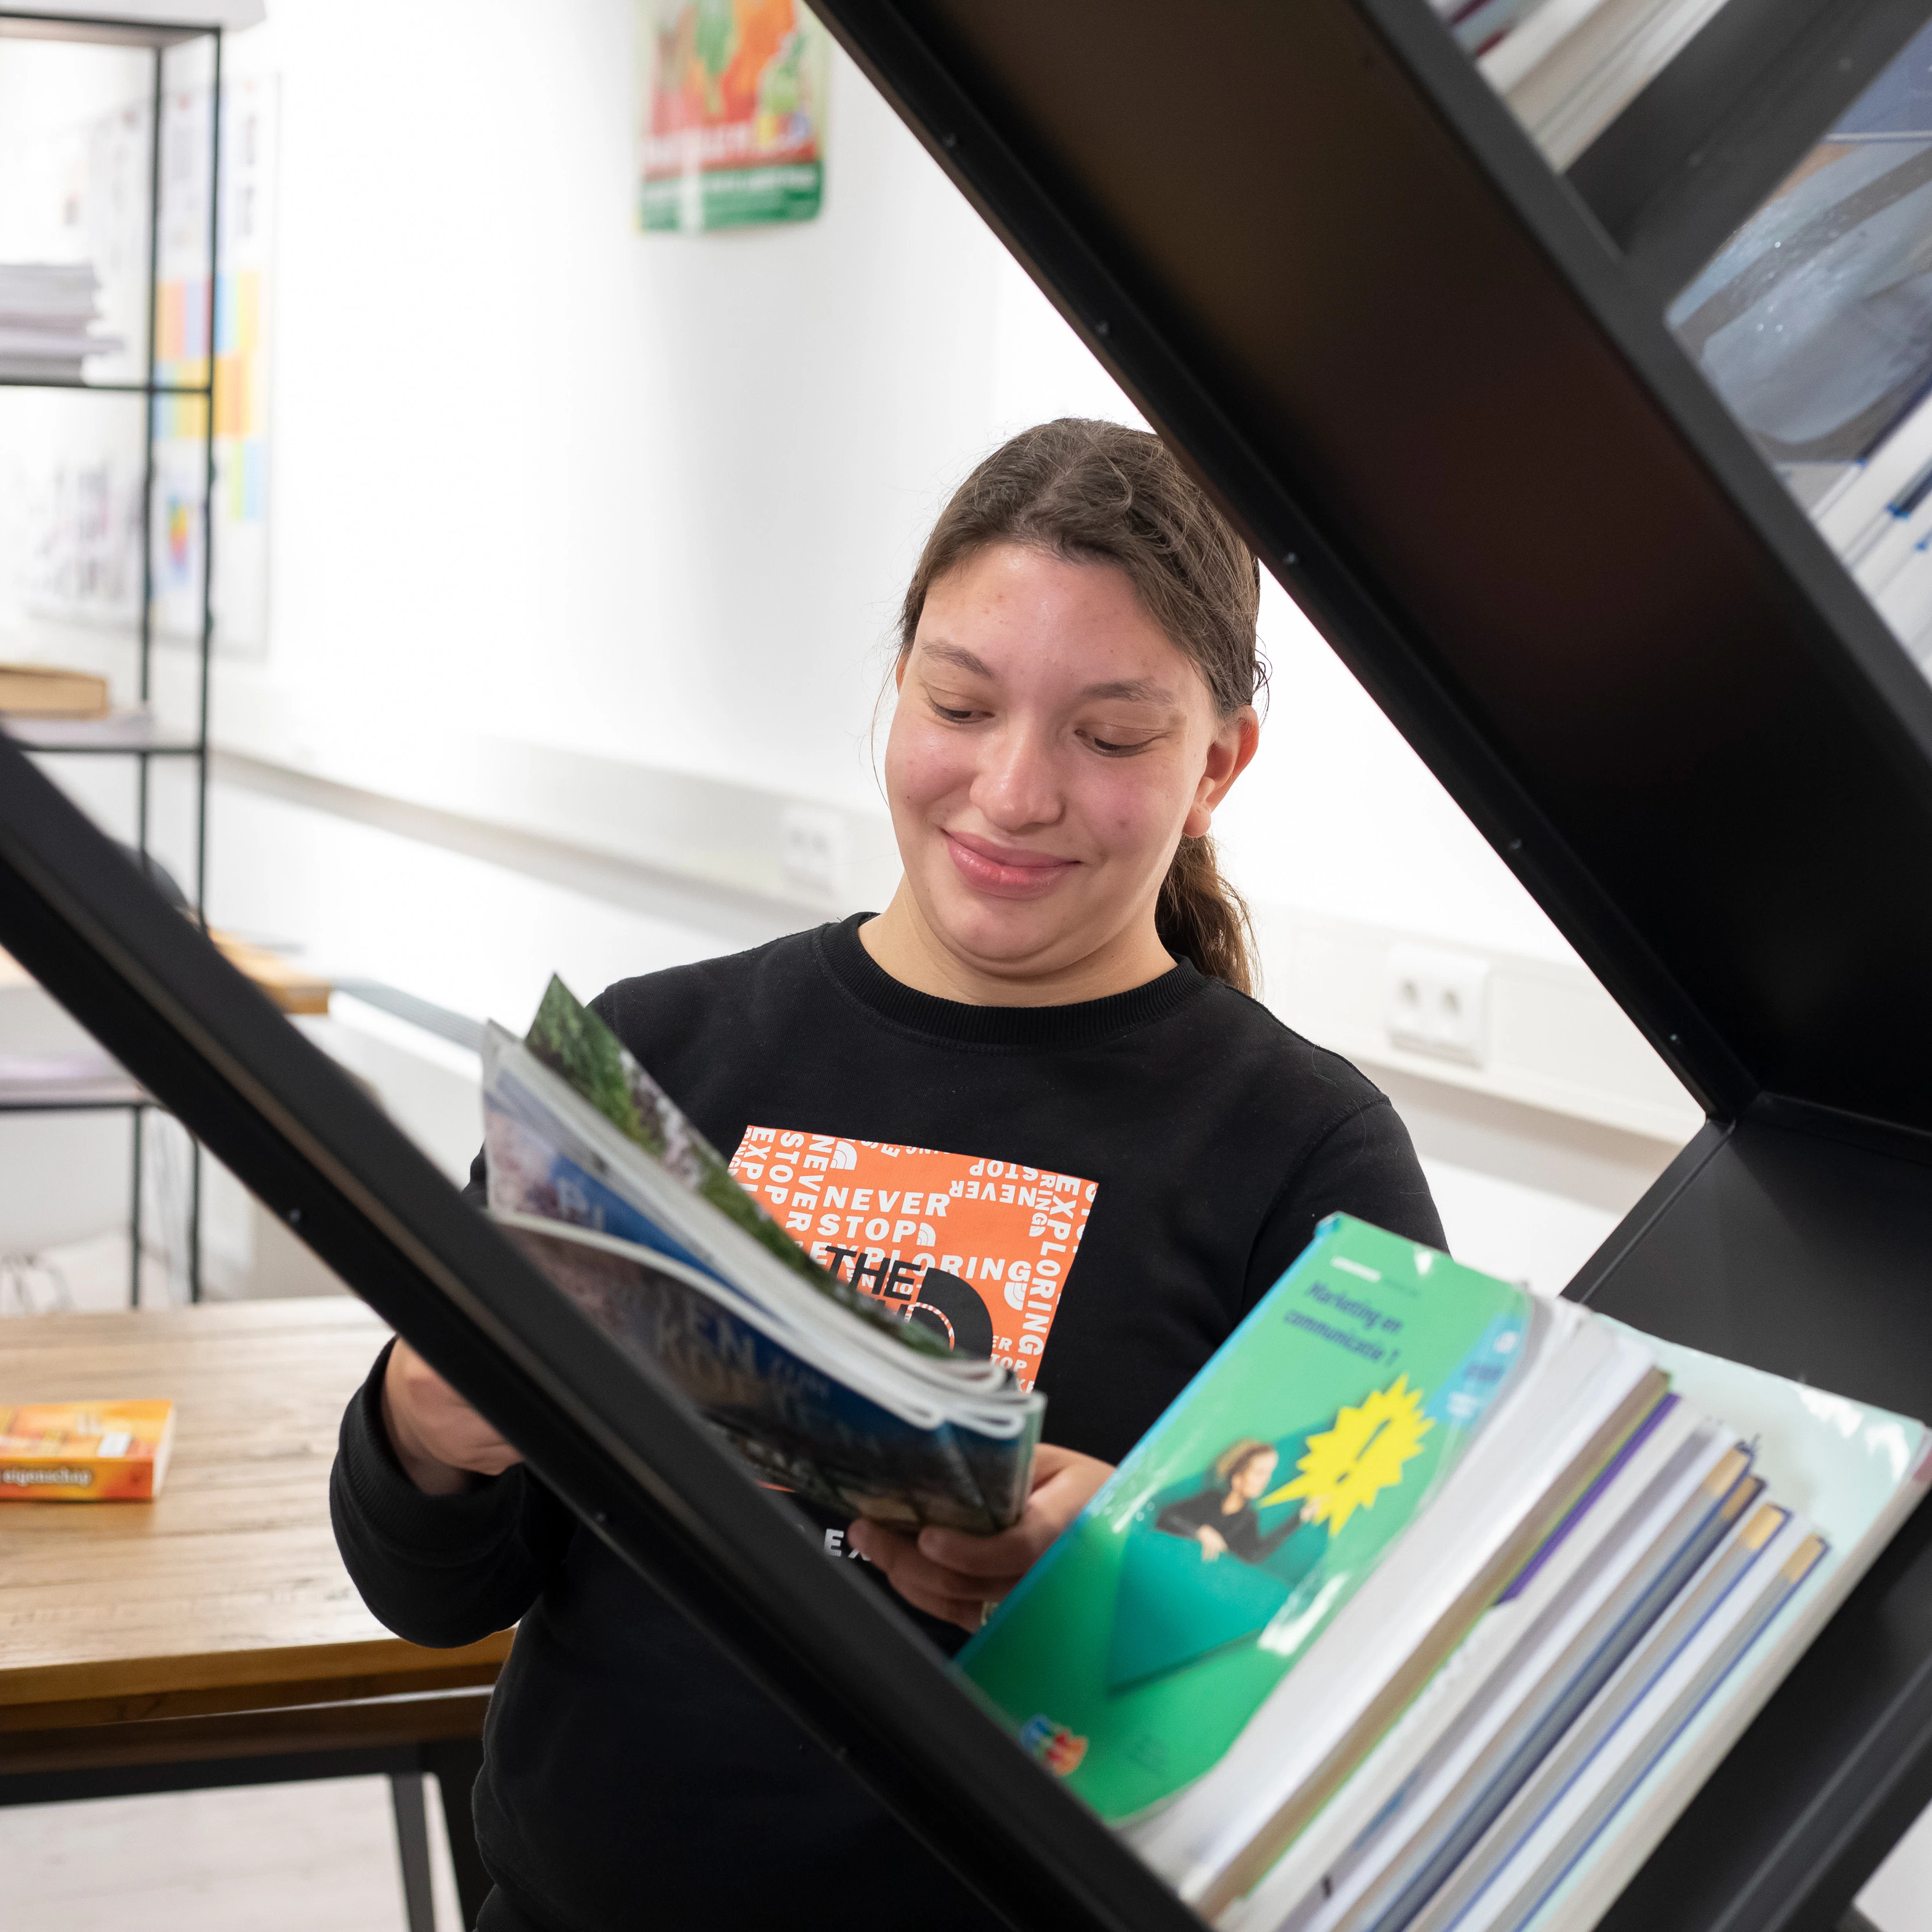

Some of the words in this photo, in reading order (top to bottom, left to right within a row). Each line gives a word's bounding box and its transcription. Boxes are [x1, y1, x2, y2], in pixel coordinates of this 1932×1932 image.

[764, 1131, 805, 1205] STOP
[785, 1134, 836, 1232] NEVER
[969, 1159, 1039, 1181] STOP
[823, 1185, 951, 1217] NEVER
[948, 1180, 1038, 1207] NEVER
[1031, 1174, 1056, 1225] RING
[816, 1213, 917, 1243] STOP
[809, 1240, 1032, 1282] EXPLORING
[825, 1245, 922, 1301] THE
[1017, 1174, 1082, 1356] EXPLORING
